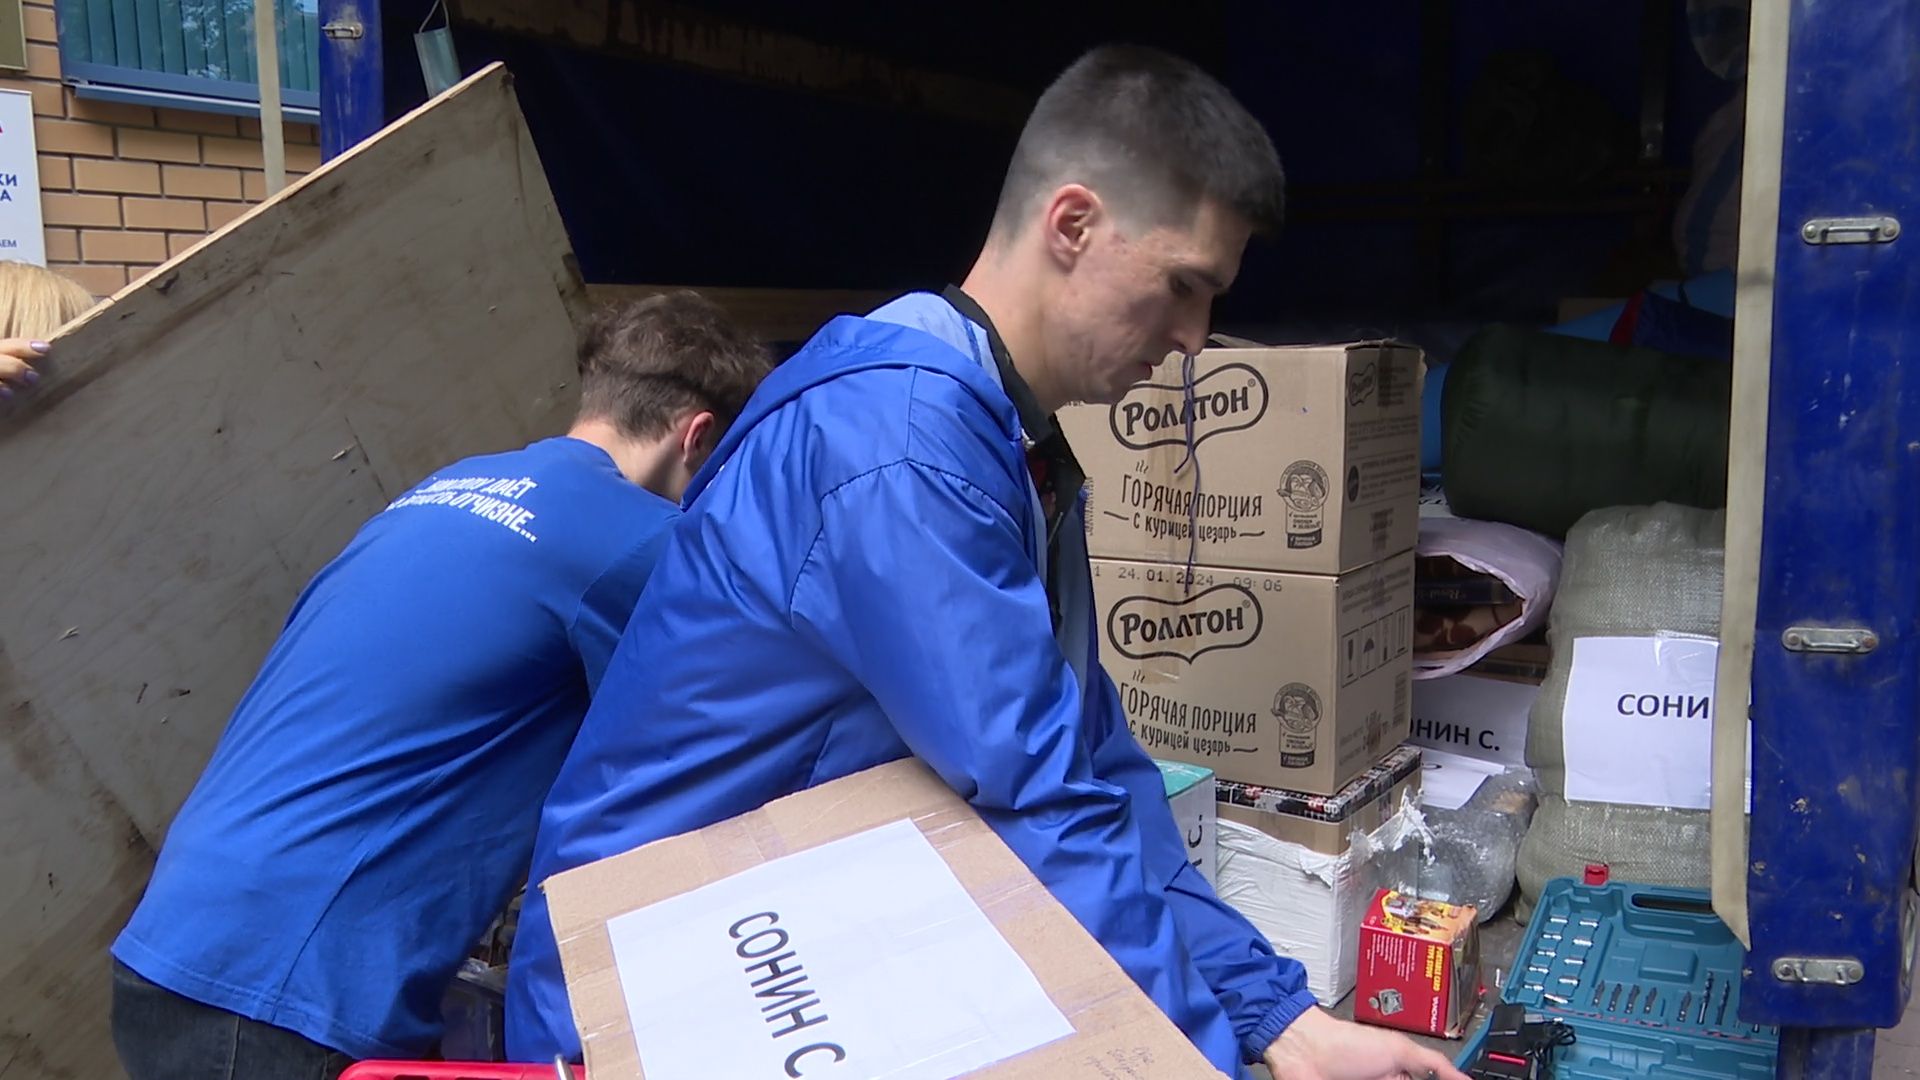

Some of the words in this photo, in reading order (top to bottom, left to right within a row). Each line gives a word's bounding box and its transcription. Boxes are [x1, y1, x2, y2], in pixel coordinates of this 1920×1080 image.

[480, 476, 538, 500] ДАЁТ
[1121, 474, 1192, 516] ГОРЯЧАЯ
[1196, 493, 1262, 522] ПОРЦИЯ
[1199, 525, 1237, 544] цезарь
[1120, 682, 1187, 727] ГОРЯЧАЯ
[1191, 706, 1257, 737] ПОРЦИЯ
[1141, 723, 1190, 750] курицей
[1193, 737, 1231, 757] цезарь
[1478, 730, 1500, 751] С.
[728, 911, 829, 1039] СОНИН
